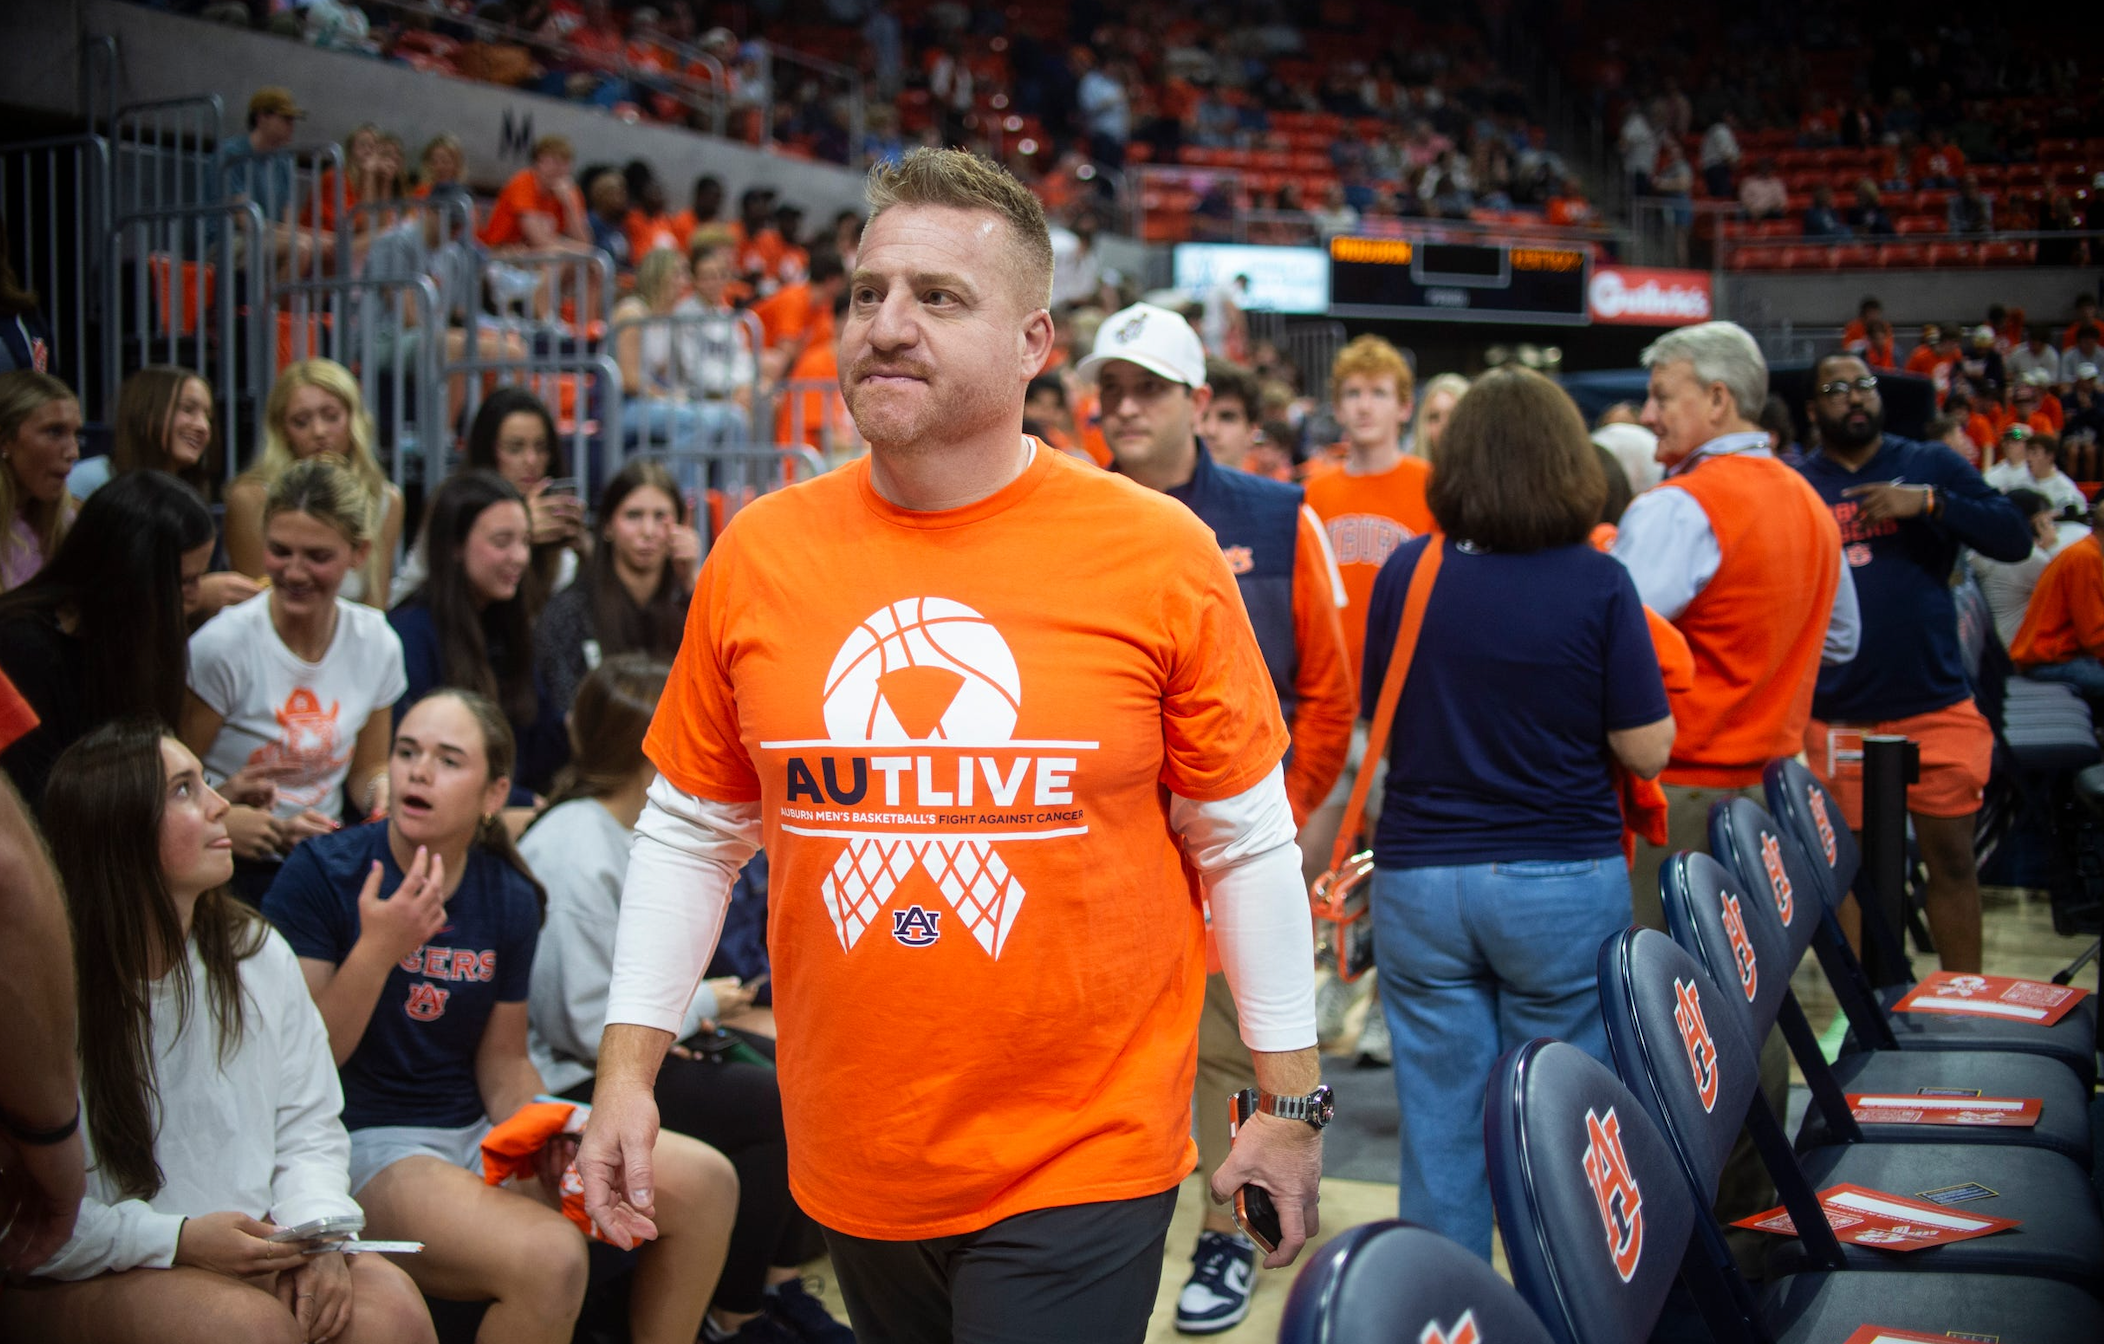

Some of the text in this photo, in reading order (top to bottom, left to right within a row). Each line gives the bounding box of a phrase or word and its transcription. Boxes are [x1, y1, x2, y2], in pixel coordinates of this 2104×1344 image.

[499, 108, 534, 161] M
[787, 756, 1077, 806] AUTLIVE
[780, 807, 1084, 824] AUBURN MEN'S BASKETBALL'S FIGHT AGAINST CANCER
